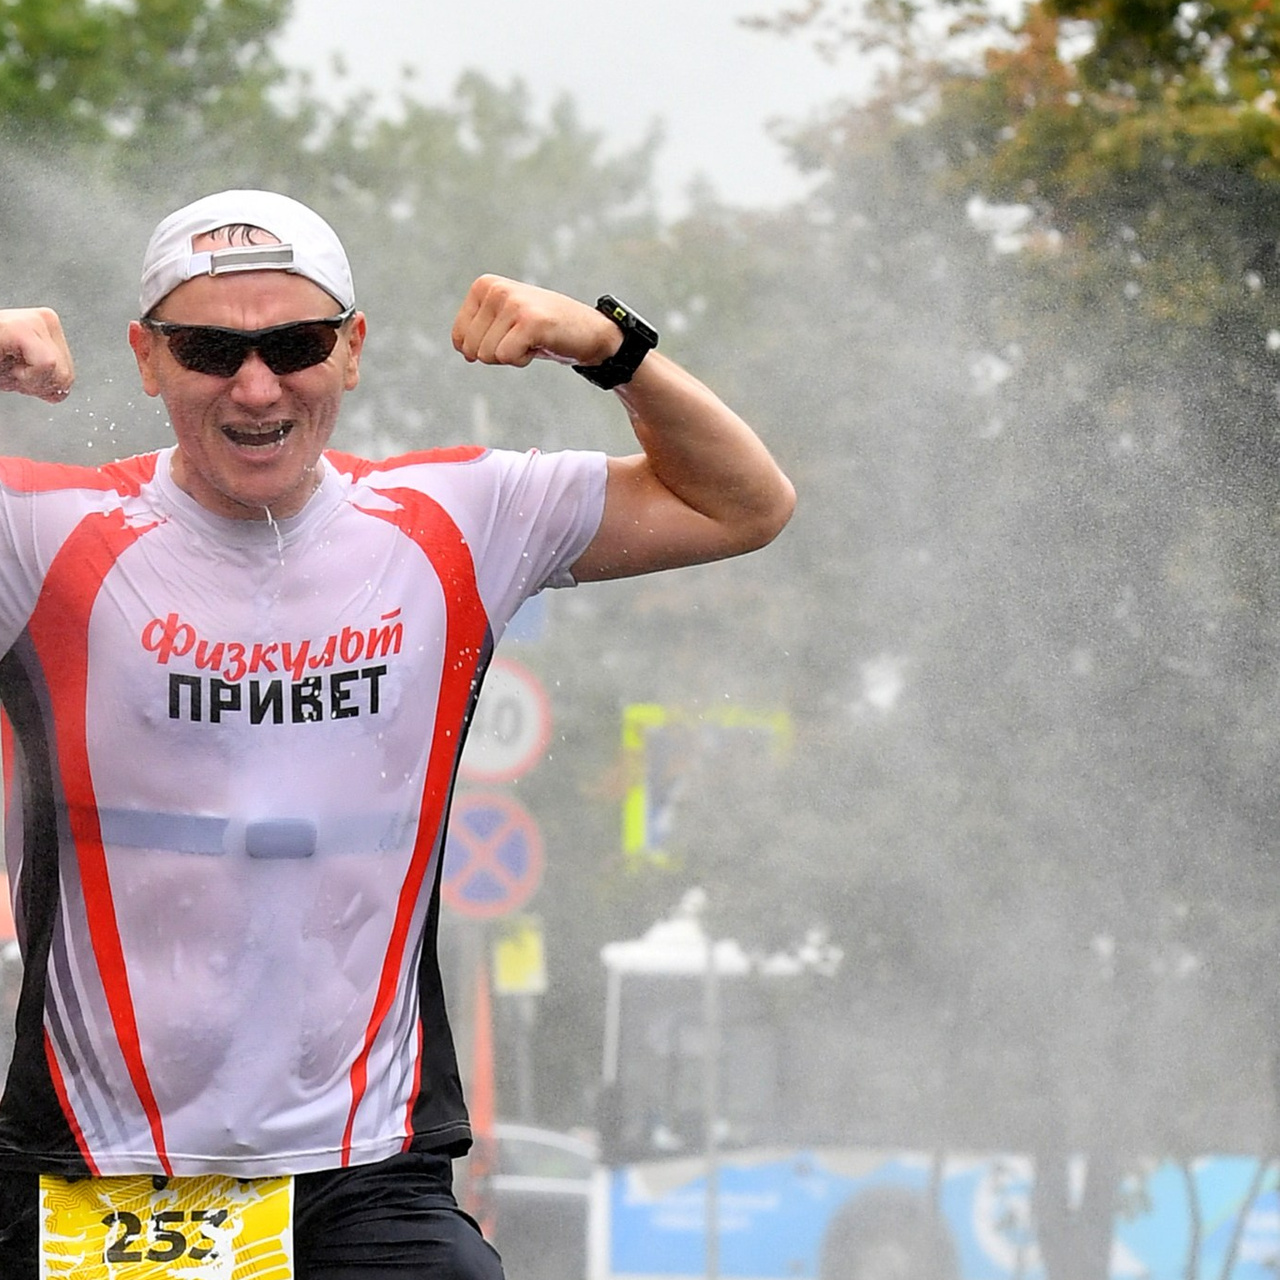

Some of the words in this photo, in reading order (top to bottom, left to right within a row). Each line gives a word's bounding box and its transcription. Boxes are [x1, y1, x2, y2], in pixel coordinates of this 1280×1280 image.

[141, 607, 404, 682] Физкульт
[168, 664, 388, 725] ПРИВЕТ
[102, 1209, 228, 1263] 253
